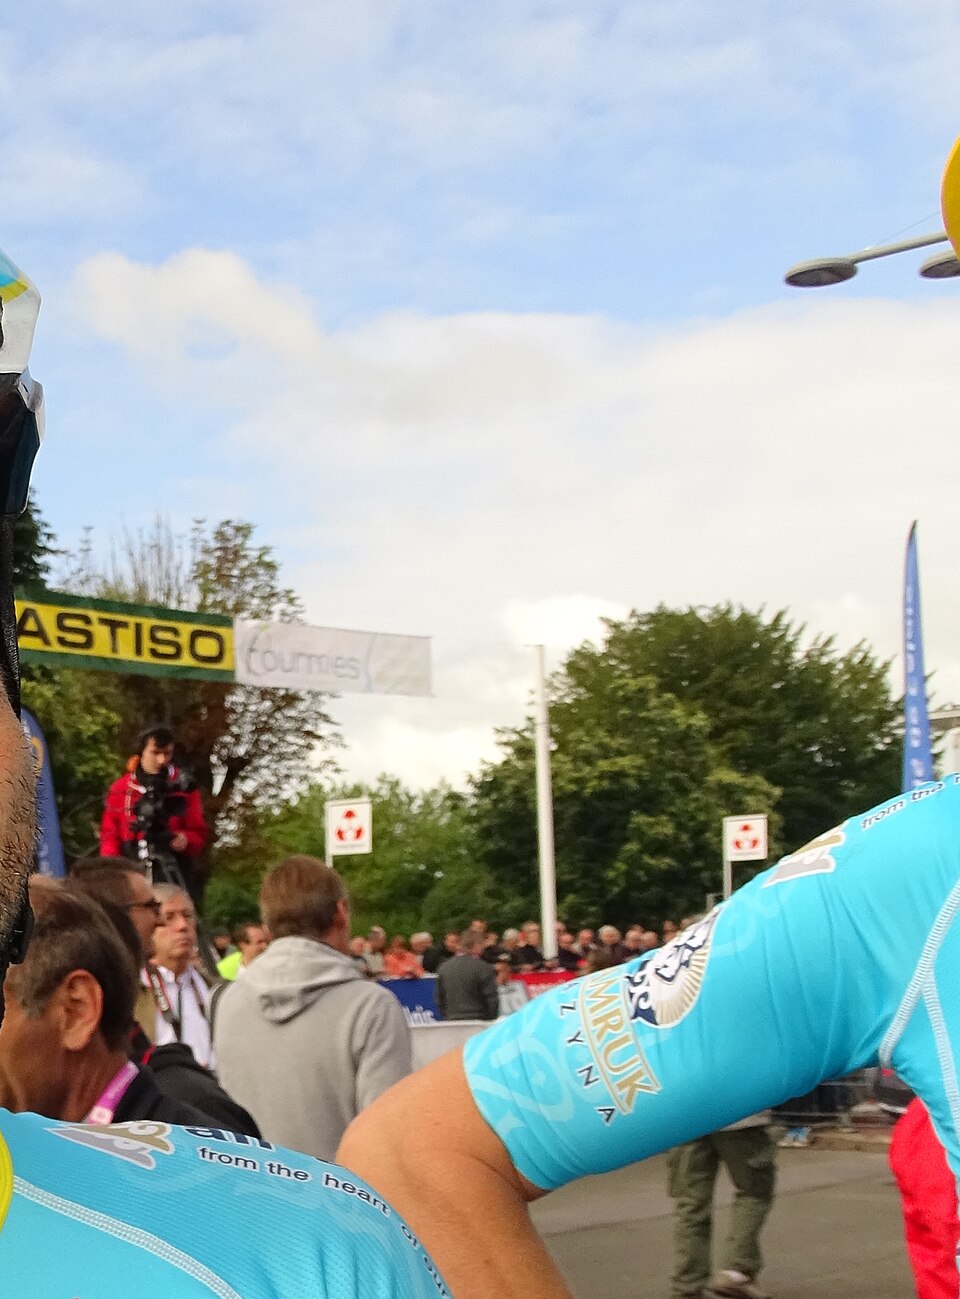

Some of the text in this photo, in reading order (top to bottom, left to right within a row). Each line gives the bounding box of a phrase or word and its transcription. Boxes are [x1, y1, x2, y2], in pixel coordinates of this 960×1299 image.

[199, 1147, 257, 1170] from
[268, 1162, 309, 1181] the
[325, 1173, 389, 1215] heart
